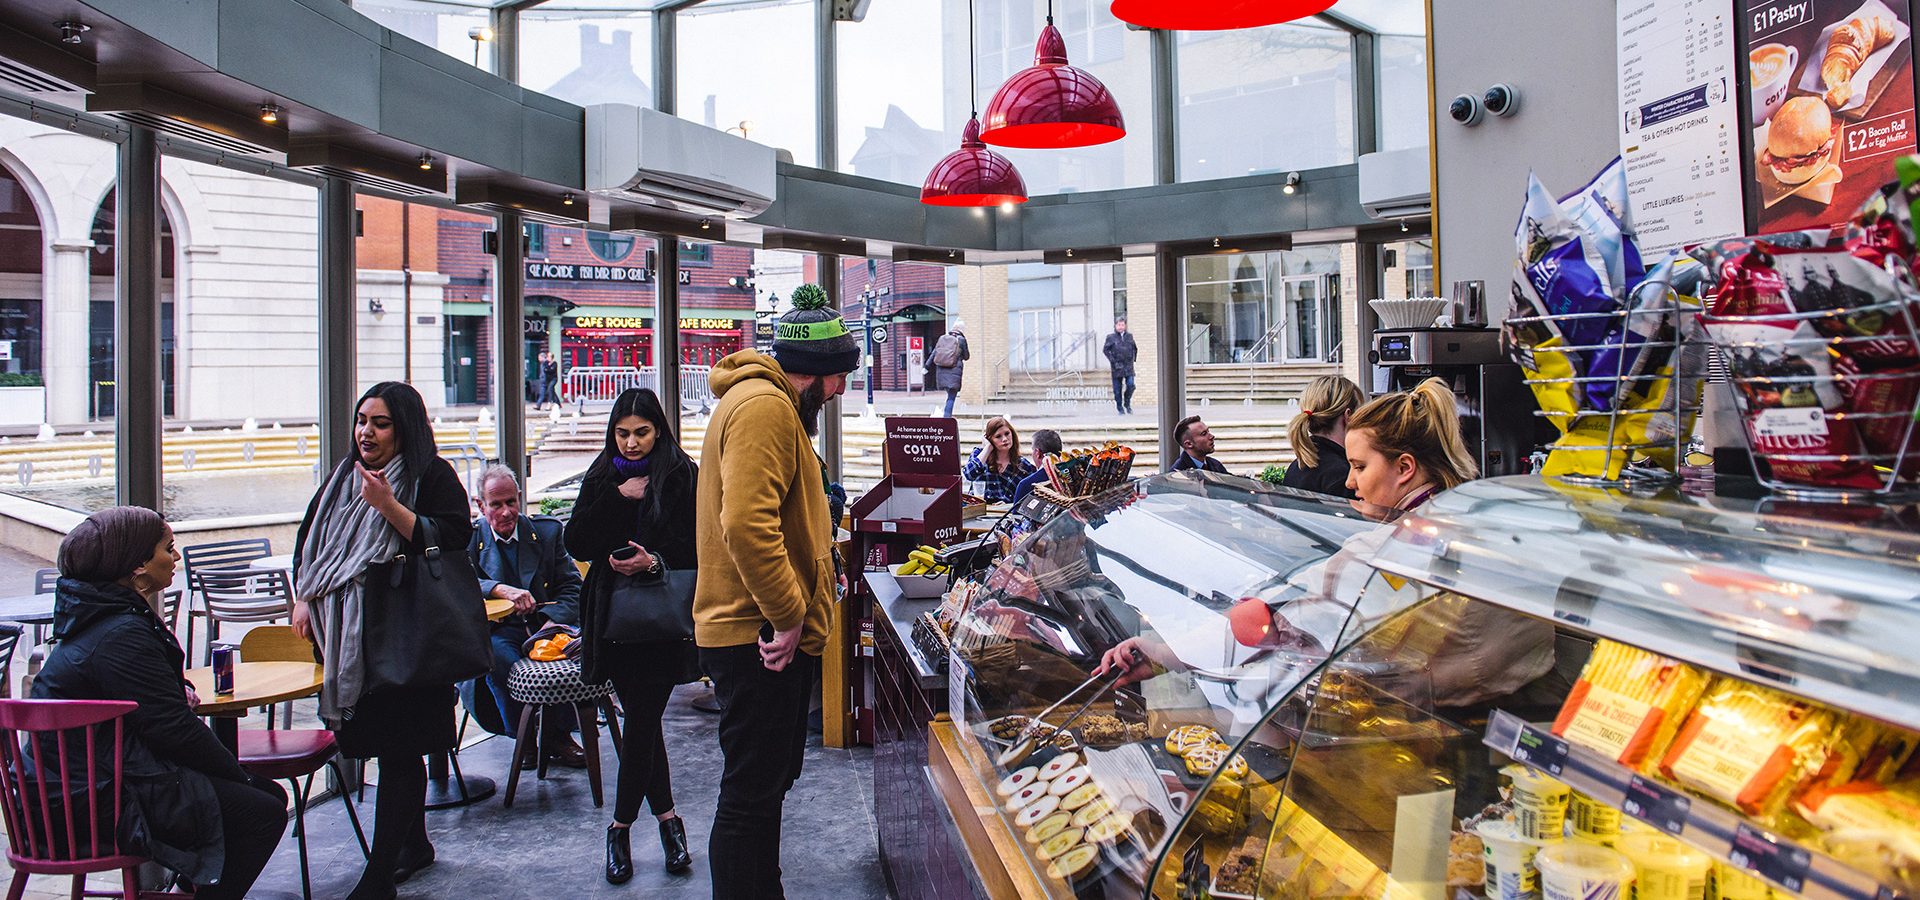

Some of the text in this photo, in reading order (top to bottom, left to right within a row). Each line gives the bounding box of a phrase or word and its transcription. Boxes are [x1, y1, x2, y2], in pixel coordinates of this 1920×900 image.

[1754, 1, 1808, 33] £1 Pastry
[1642, 133, 1652, 142] TEA
[1656, 125, 1674, 138] OTHER
[1675, 122, 1686, 133] HOT
[1687, 115, 1708, 128] DRINKS
[1868, 119, 1906, 138] Bacon Roll
[1848, 129, 1867, 152] £2
[1875, 137, 1887, 148] Egg
[1643, 199, 1658, 210] LITTLE
[1658, 195, 1684, 207] LUXURIES
[542, 264, 574, 278] MONDE
[579, 266, 593, 279] FISH
[595, 267, 610, 280] BAR
[610, 267, 626, 280] AND
[627, 268, 646, 281] GRILL
[606, 317, 642, 329] ROUGE
[700, 318, 734, 329] ROUGE
[930, 433, 942, 442] enjoy
[903, 444, 941, 457] COSTA
[934, 526, 958, 541] COSTA
[1584, 697, 1603, 714] HAM
[1598, 727, 1628, 745] TOASTIE
